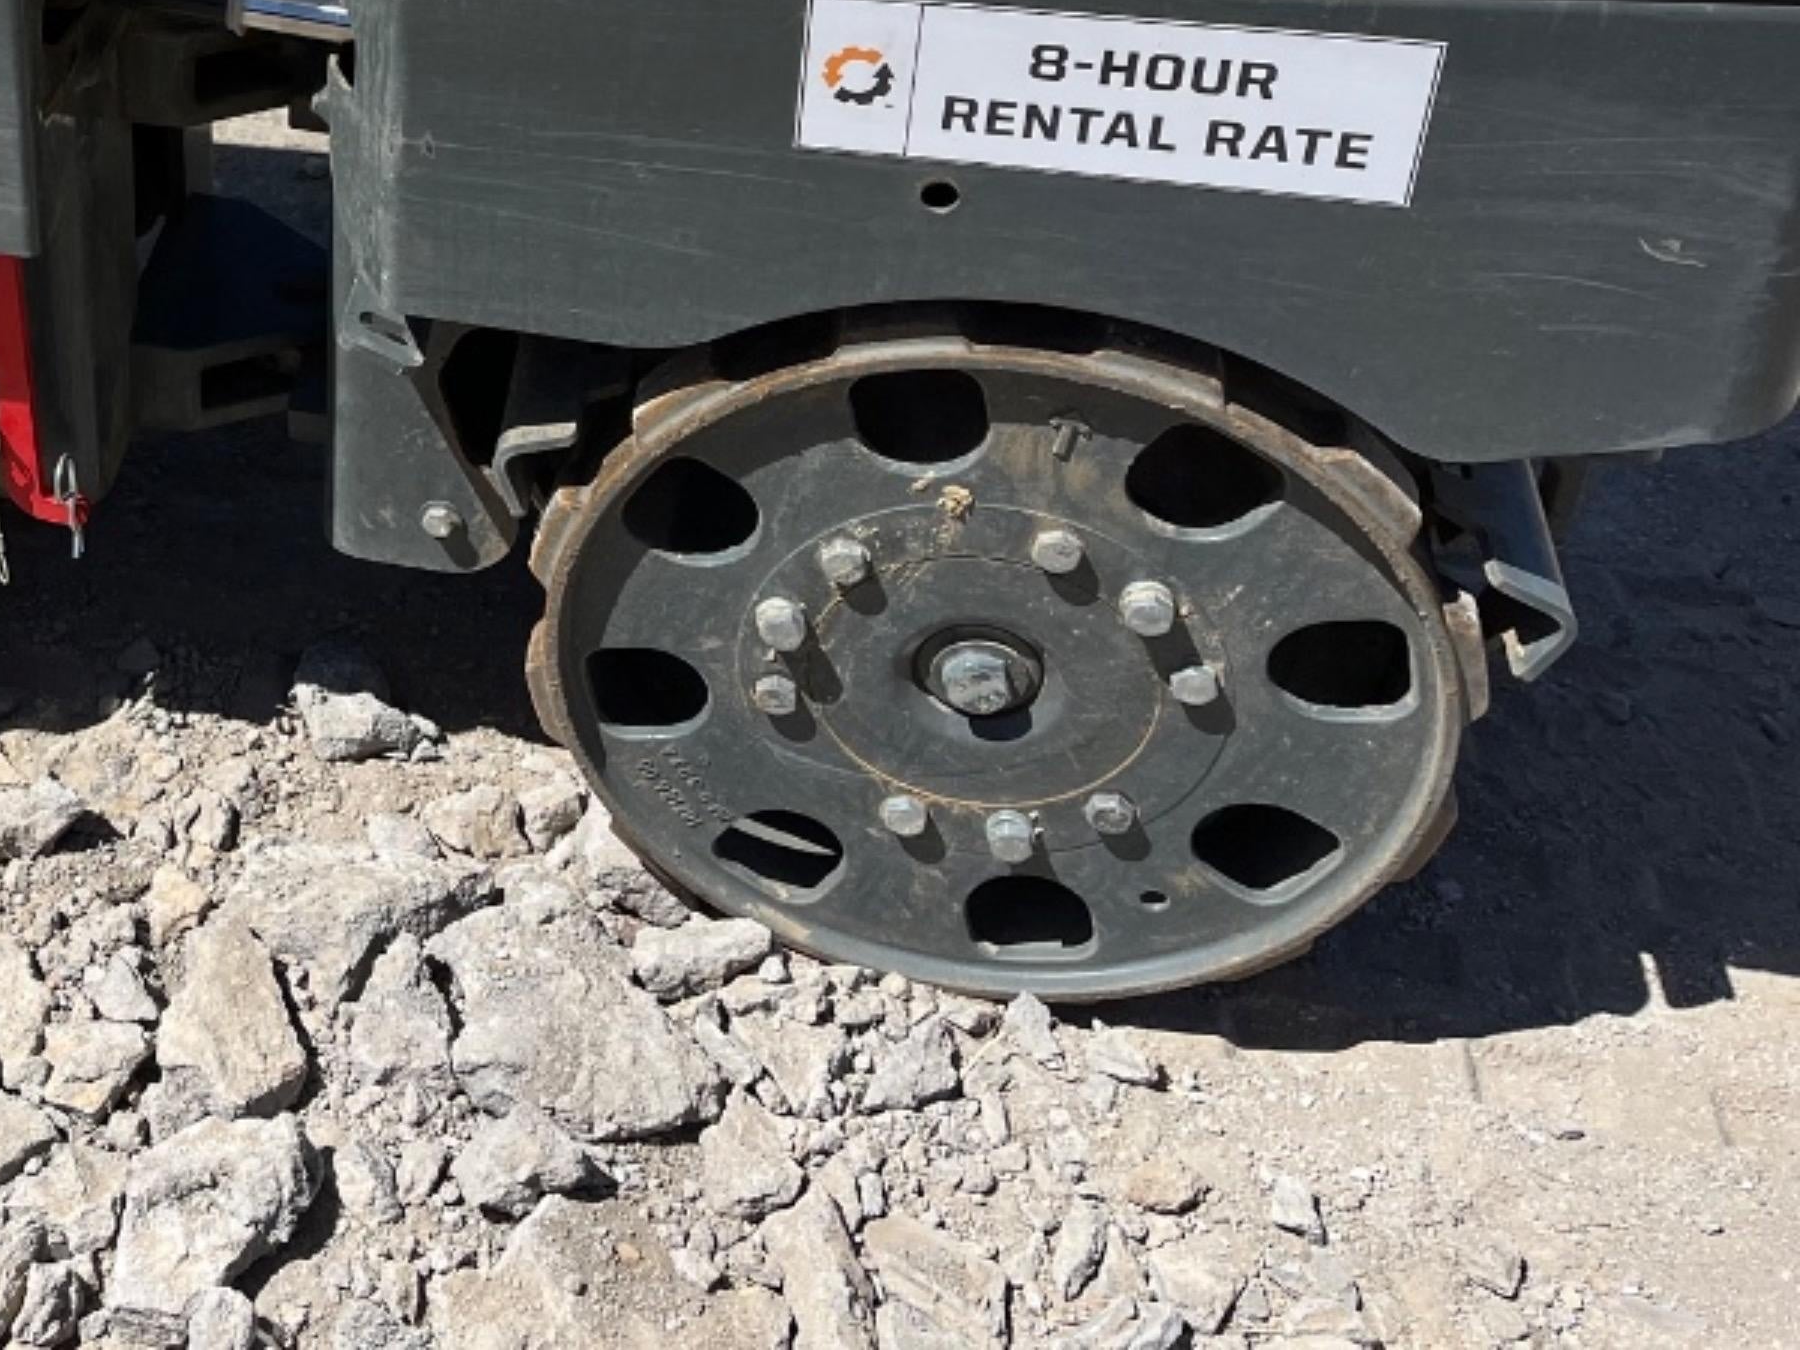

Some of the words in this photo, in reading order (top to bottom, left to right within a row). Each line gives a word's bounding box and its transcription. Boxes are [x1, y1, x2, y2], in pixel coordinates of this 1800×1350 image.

[1029, 44, 1279, 100] 8-HOUR
[939, 94, 1177, 152] RENTAL
[1204, 119, 1374, 170] RATE
